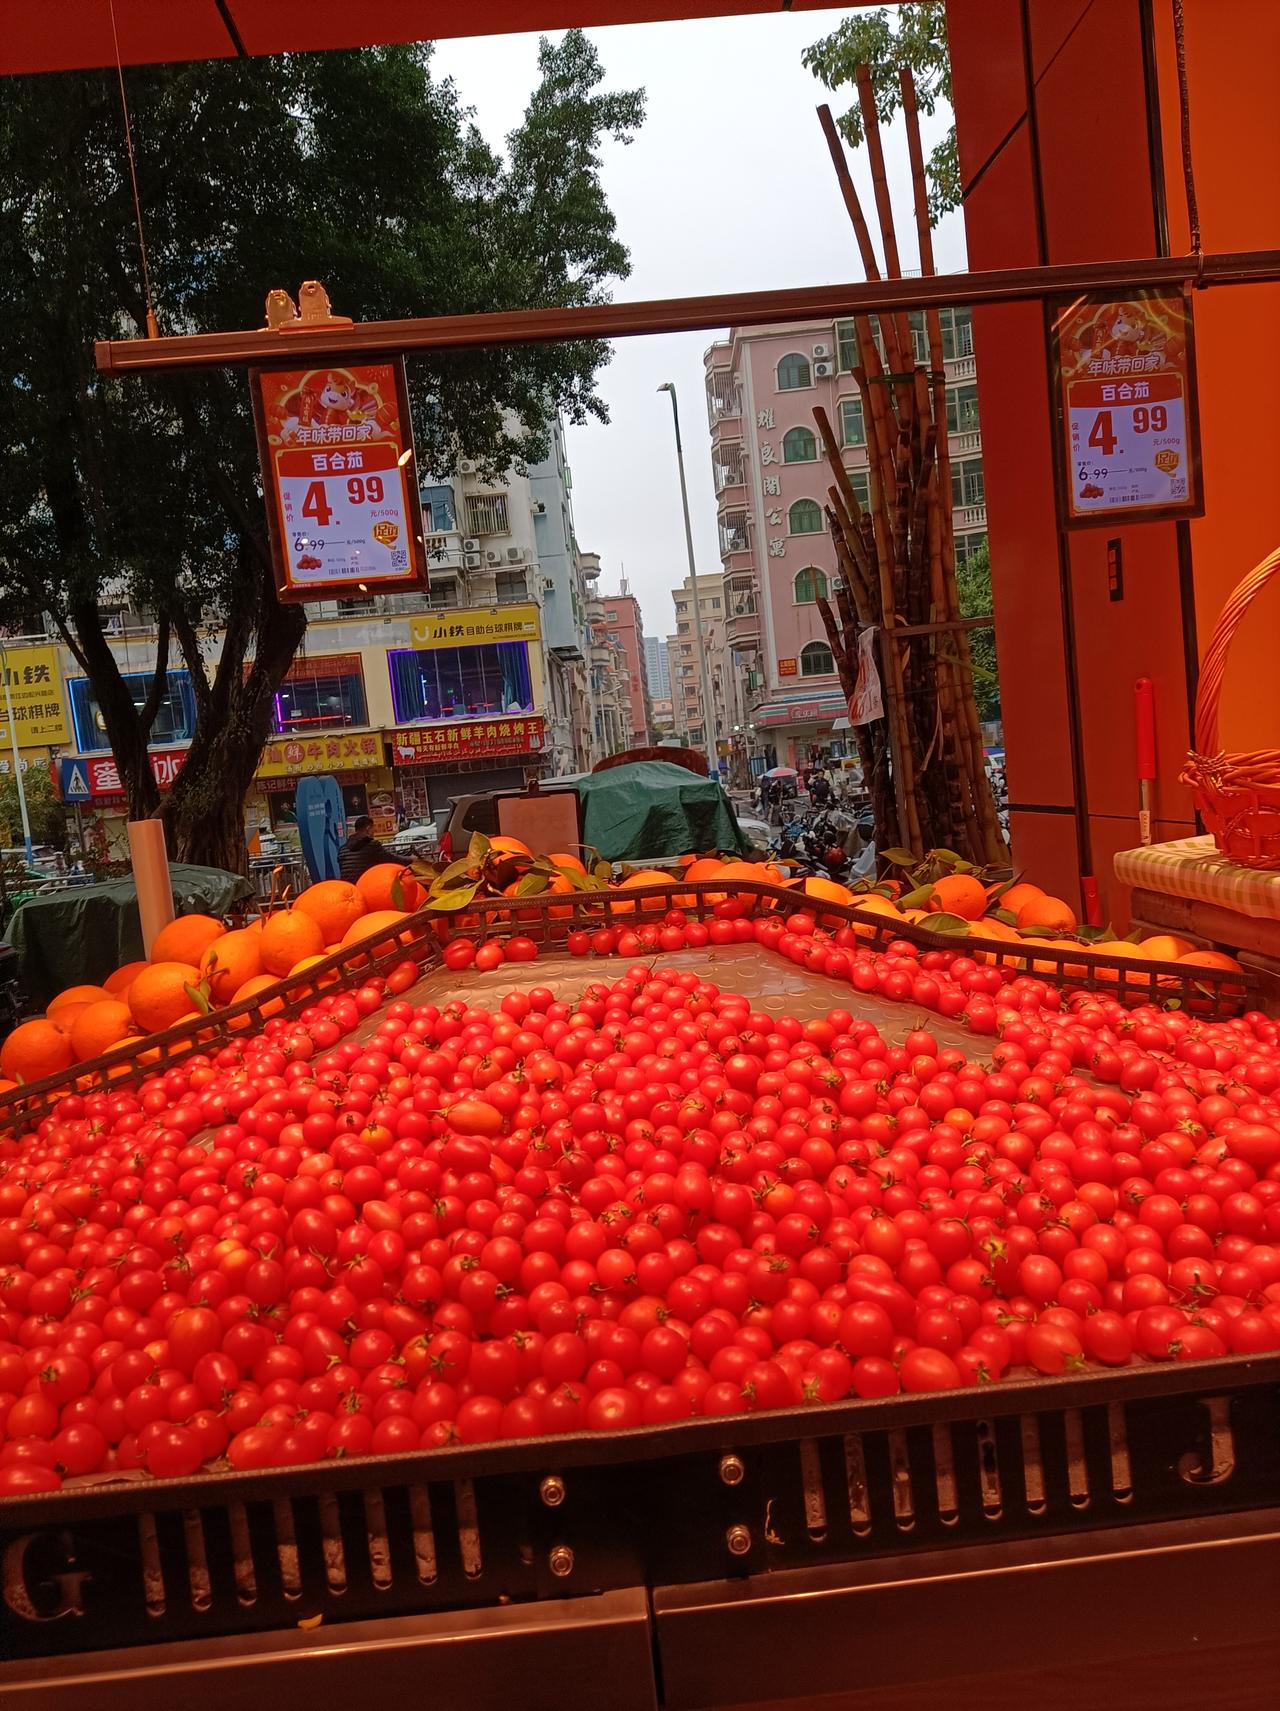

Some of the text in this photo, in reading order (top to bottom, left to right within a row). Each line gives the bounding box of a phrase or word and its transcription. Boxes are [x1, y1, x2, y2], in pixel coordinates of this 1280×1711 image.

[1088, 354, 1160, 377] 年味带回家
[1101, 381, 1150, 401] 百合茄
[296, 425, 372, 446] 年味带回家
[311, 450, 364, 471] 百合茄
[1079, 466, 1109, 481] 6.99
[370, 509, 399, 518] 元/500g
[294, 537, 325, 552] 6.99
[433, 625, 464, 639] 小铁
[466, 621, 523, 636] 自助台球棋牌
[396, 721, 539, 747] 新疆玉石新鲜羊肉烧烤王
